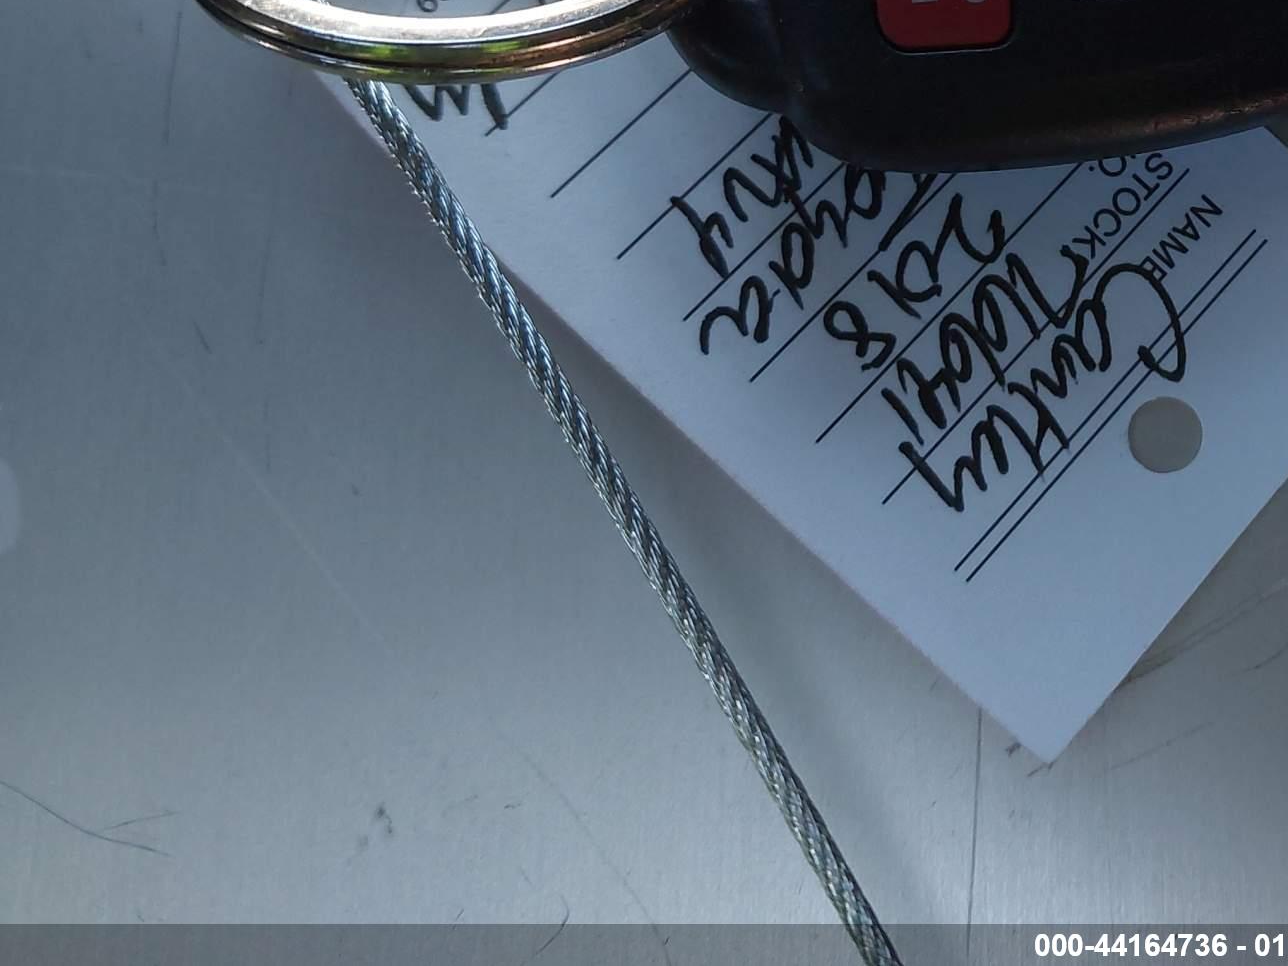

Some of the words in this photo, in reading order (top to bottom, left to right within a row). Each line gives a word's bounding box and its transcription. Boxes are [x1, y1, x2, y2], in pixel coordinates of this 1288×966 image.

[670, 115, 813, 280] AV4
[1072, 152, 1173, 259] STOCK
[1148, 194, 1223, 282] NAME
[823, 192, 1005, 372] 2018
